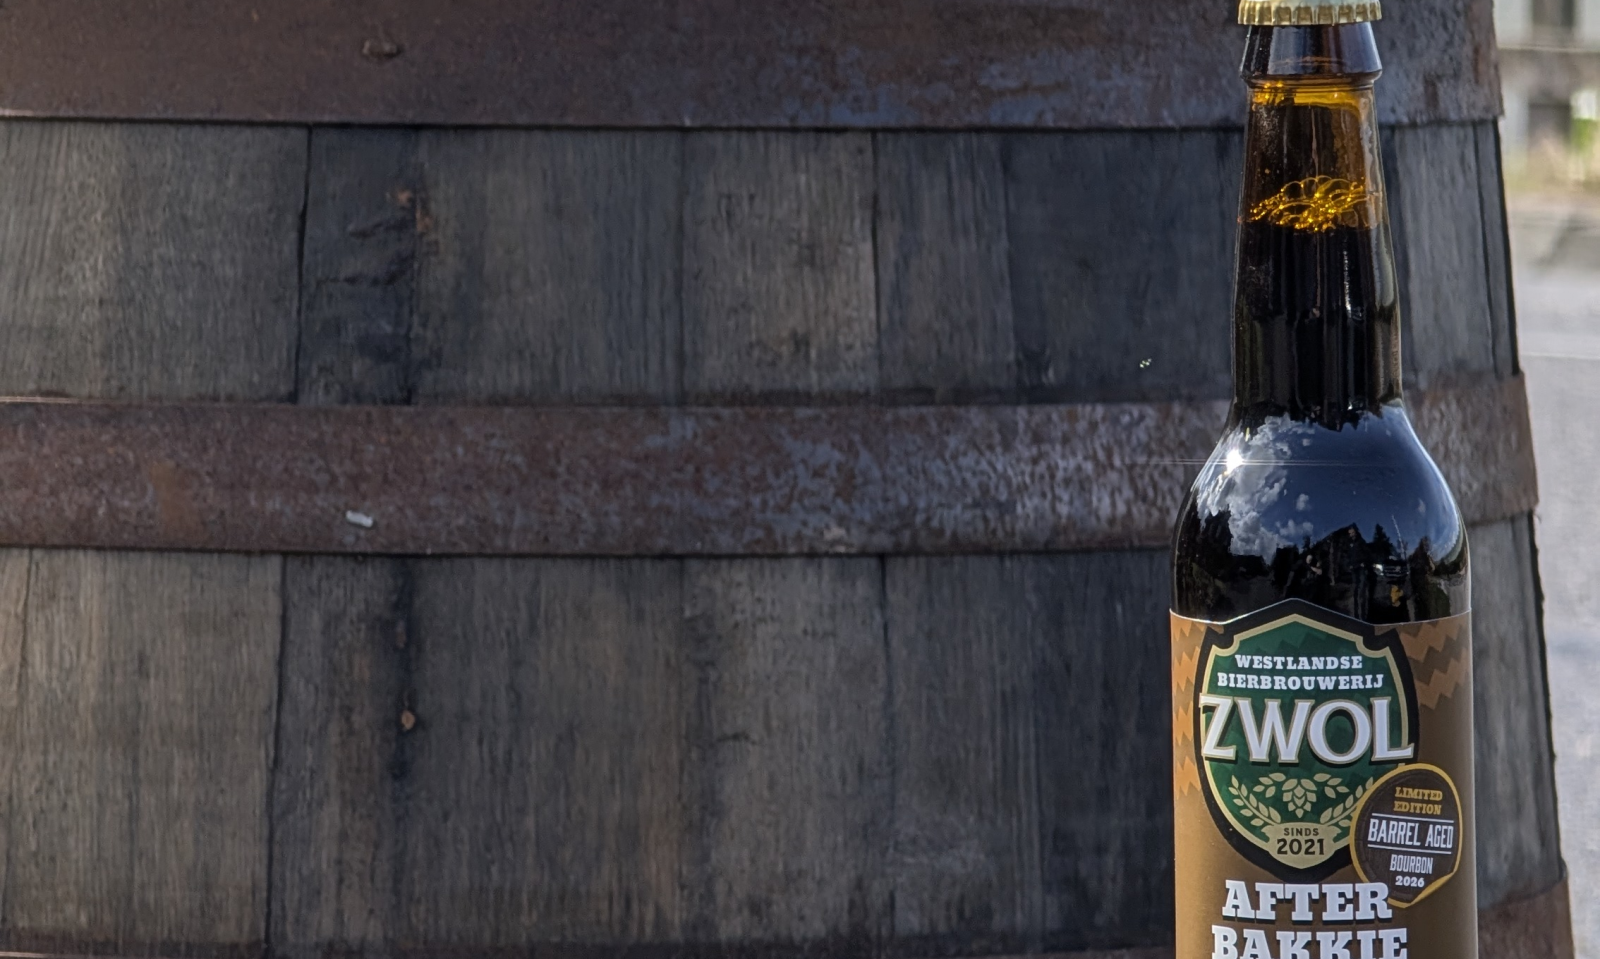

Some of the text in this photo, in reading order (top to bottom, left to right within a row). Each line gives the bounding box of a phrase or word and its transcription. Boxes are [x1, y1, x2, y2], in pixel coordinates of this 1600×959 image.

[1234, 654, 1363, 670] WESTLANDSE
[1217, 672, 1384, 690] BIERBROUWERIJ
[1198, 692, 1415, 764] ZWOL
[1394, 786, 1443, 801] LIMITED
[1393, 801, 1442, 815] EDITION
[1283, 827, 1320, 837] SINDS
[1367, 818, 1454, 849] BARREL AGED
[1276, 838, 1325, 855] 2021
[1389, 854, 1434, 874] BOURBON
[1395, 875, 1425, 888] 2026
[1221, 879, 1393, 921] AFTER
[1211, 924, 1408, 959] BAKKIE
